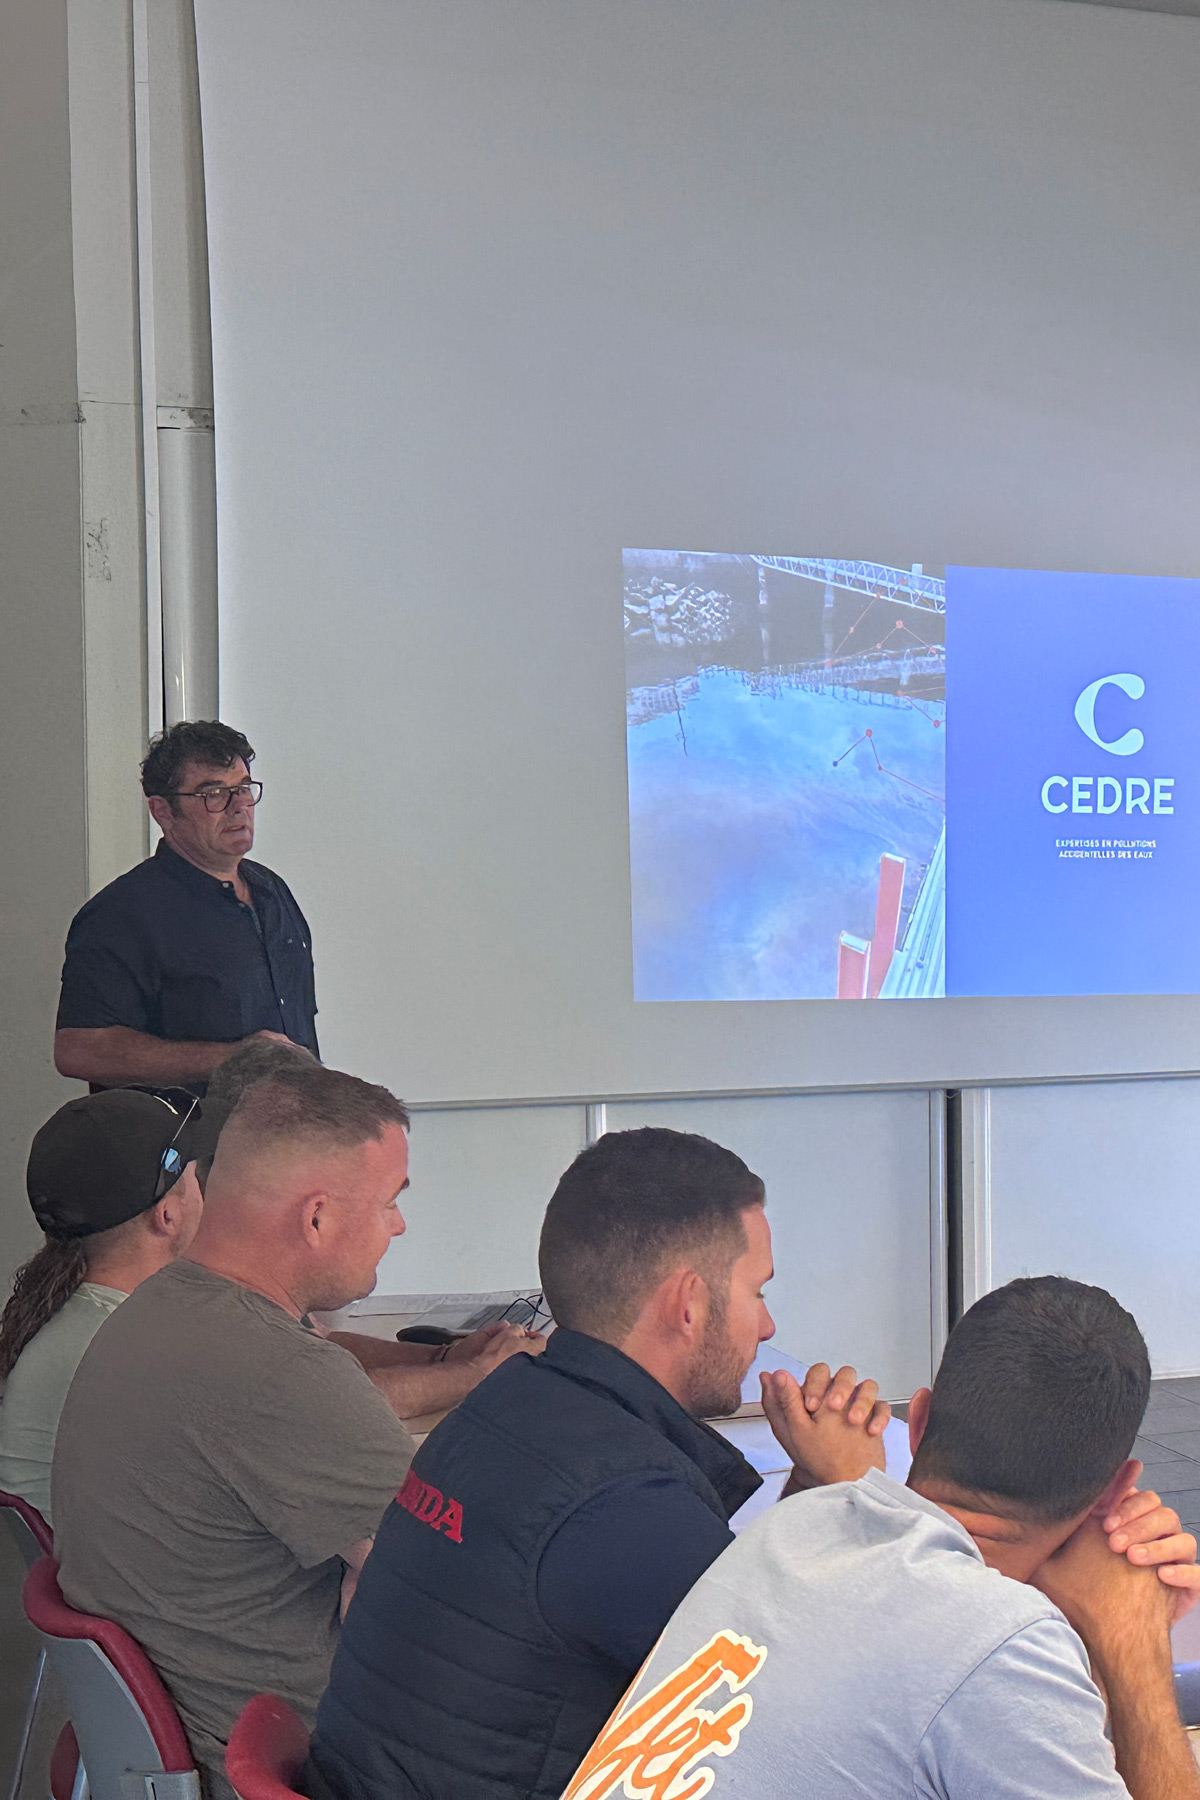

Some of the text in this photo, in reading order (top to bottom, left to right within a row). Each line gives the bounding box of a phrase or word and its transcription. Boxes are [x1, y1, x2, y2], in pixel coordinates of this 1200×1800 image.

[1041, 775, 1175, 814] CEDRE
[1055, 839, 1156, 848] EXPERTISES EN POLLUTIONS
[1059, 850, 1116, 858] ACCIDENTELLES
[1117, 850, 1132, 858] DES
